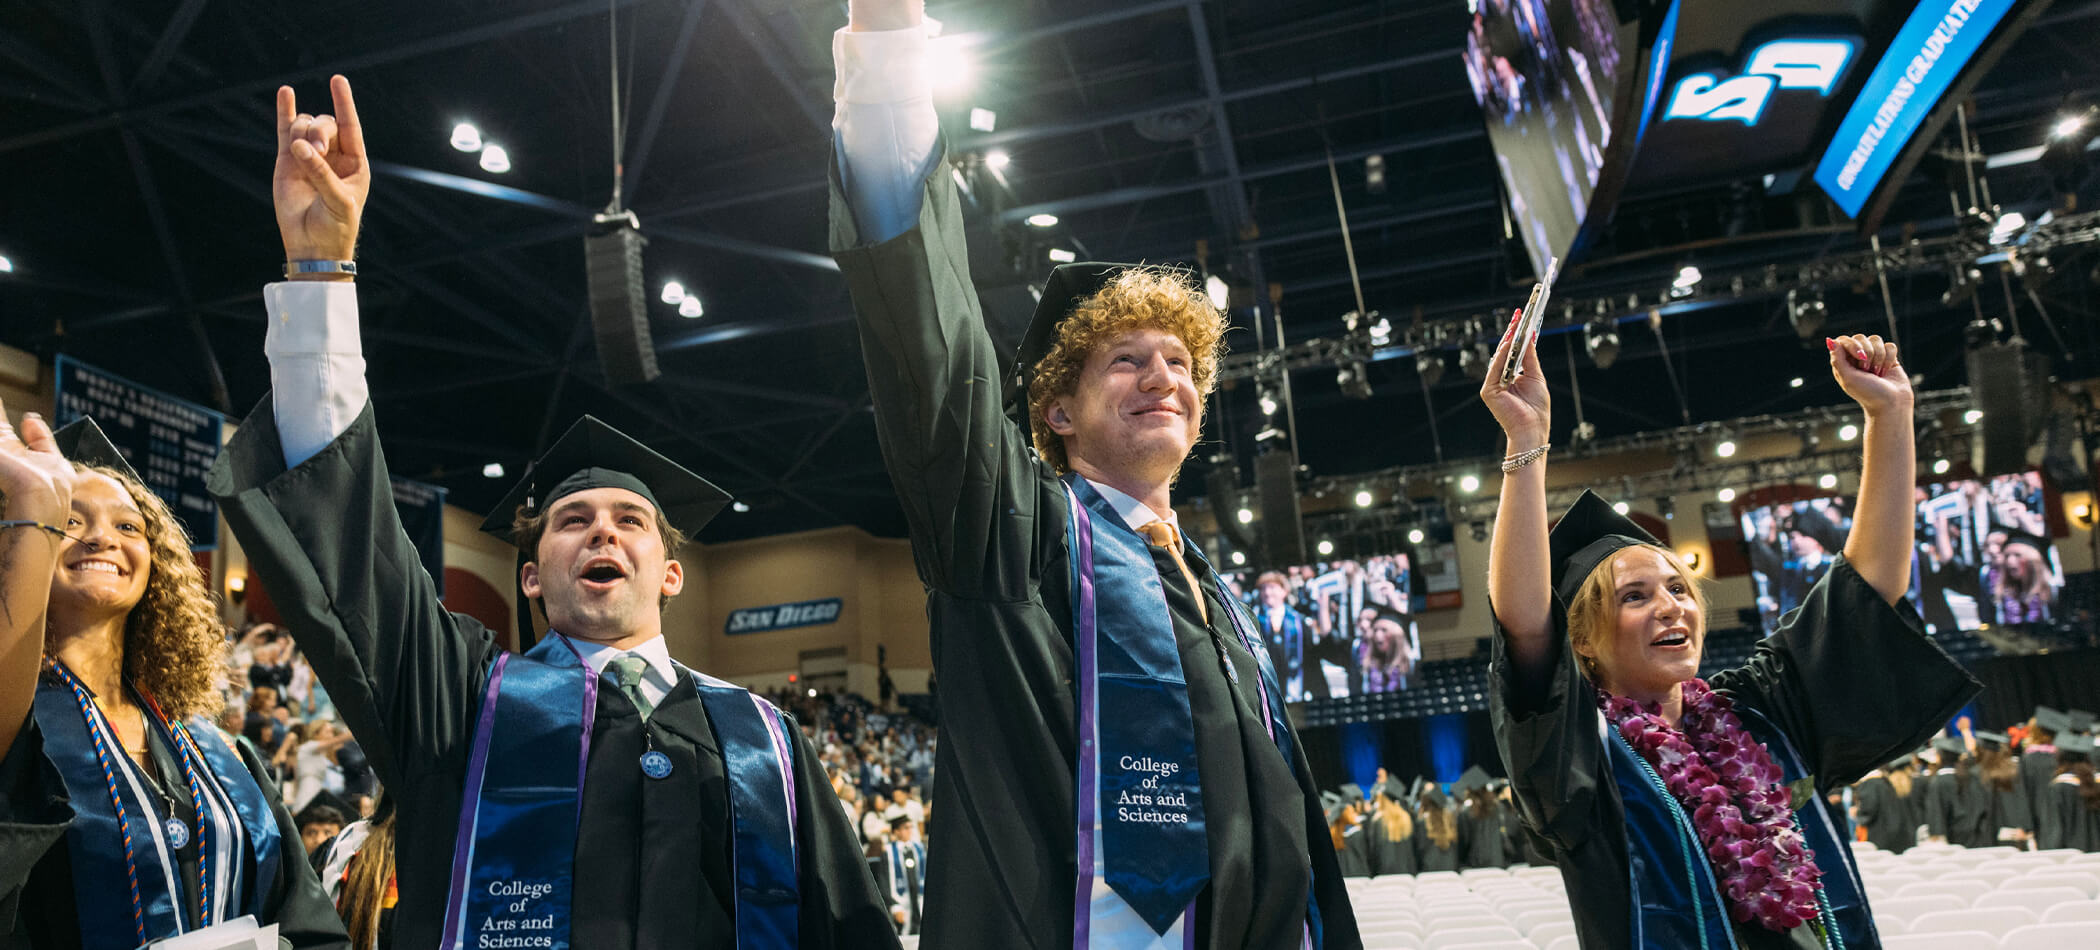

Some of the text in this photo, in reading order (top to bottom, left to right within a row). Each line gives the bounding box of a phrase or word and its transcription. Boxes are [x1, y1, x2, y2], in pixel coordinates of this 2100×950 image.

[1664, 39, 1854, 126] SD
[1120, 755, 1179, 777] College
[1142, 774, 1159, 789] of
[1117, 789, 1187, 807] Arts and
[1118, 807, 1188, 824] Sciences
[488, 881, 552, 898] College
[509, 898, 528, 913] of
[480, 914, 553, 931] Arts and
[479, 934, 552, 949] Sciences
